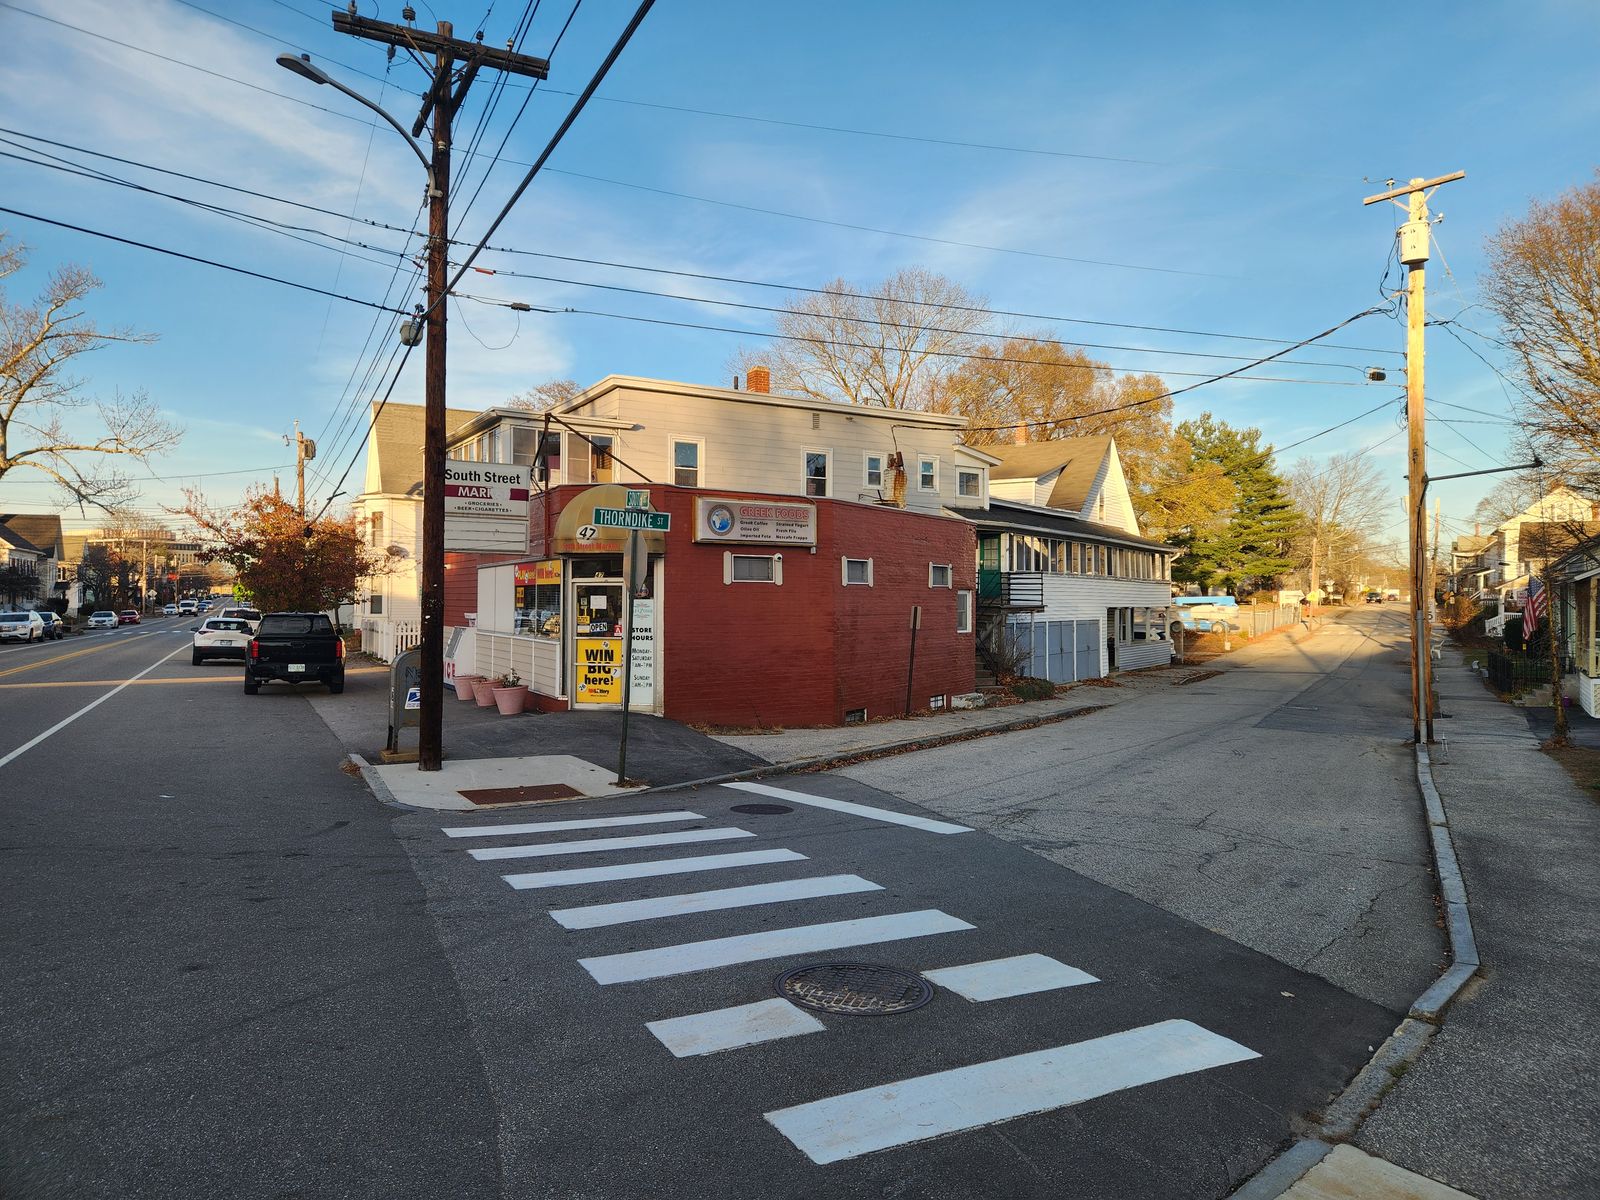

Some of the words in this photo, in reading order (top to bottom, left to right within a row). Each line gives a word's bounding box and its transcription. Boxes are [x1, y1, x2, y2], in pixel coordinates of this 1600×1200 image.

[445, 469, 480, 482] South
[484, 471, 521, 484] Street
[600, 510, 653, 527] THORNDIKE
[657, 517, 664, 525] ST
[740, 506, 773, 518] GREEK
[775, 508, 809, 520] FOODS
[579, 527, 596, 541] 47
[591, 623, 607, 631] OPEN
[585, 649, 614, 661] WIN
[588, 662, 611, 674] BIG
[584, 674, 614, 685] here!
